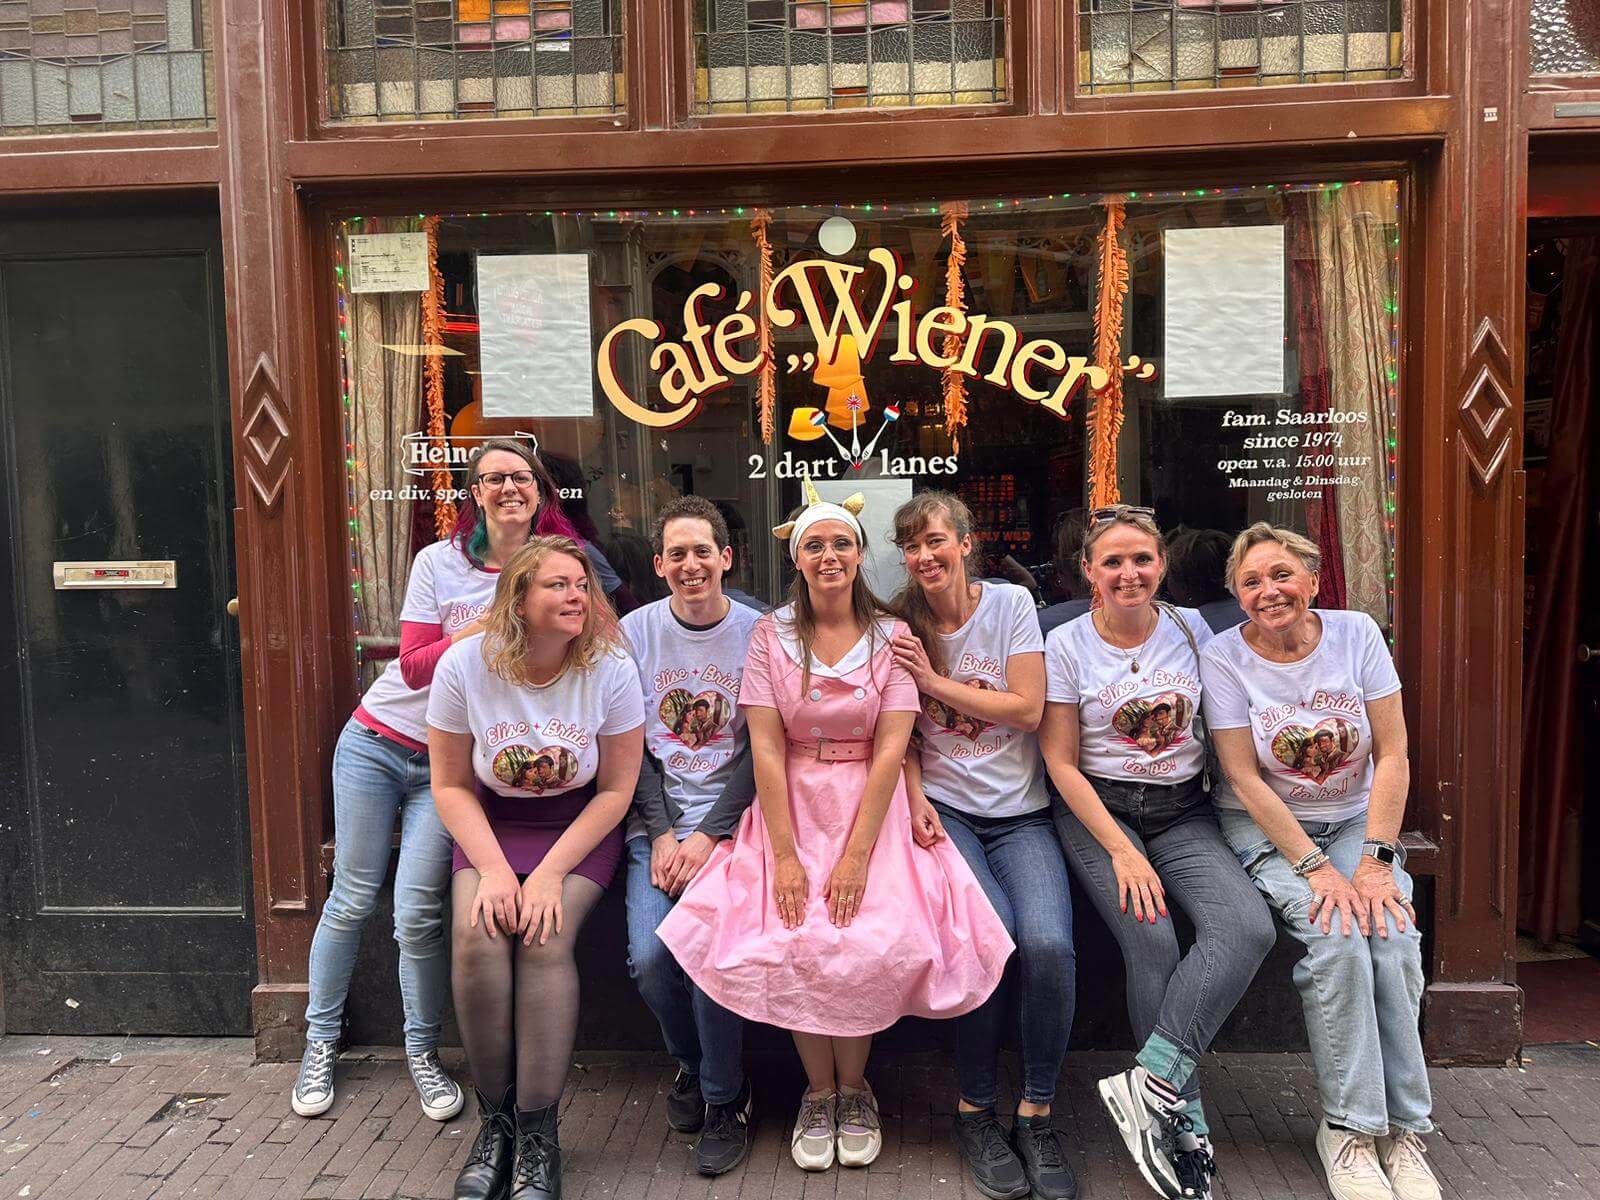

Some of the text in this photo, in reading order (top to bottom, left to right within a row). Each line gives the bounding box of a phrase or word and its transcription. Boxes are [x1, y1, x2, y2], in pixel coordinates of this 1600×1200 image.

[597, 282, 763, 428] Café
[1222, 407, 1368, 427] fam. Saarloos
[1243, 431, 1343, 449] since 1974
[748, 448, 959, 479] 2 dart lanes
[1217, 454, 1371, 473] open v.a. 15.00 uur
[1229, 474, 1361, 488] Maandag & Dinsdag
[369, 489, 394, 500] en
[398, 485, 431, 500] div.
[1266, 488, 1322, 502] gesloten
[959, 653, 1002, 679] Bride
[653, 663, 741, 697] Elise Bride
[1310, 690, 1363, 717] Bride
[485, 717, 590, 749] Elise Bride
[950, 744, 971, 758] to
